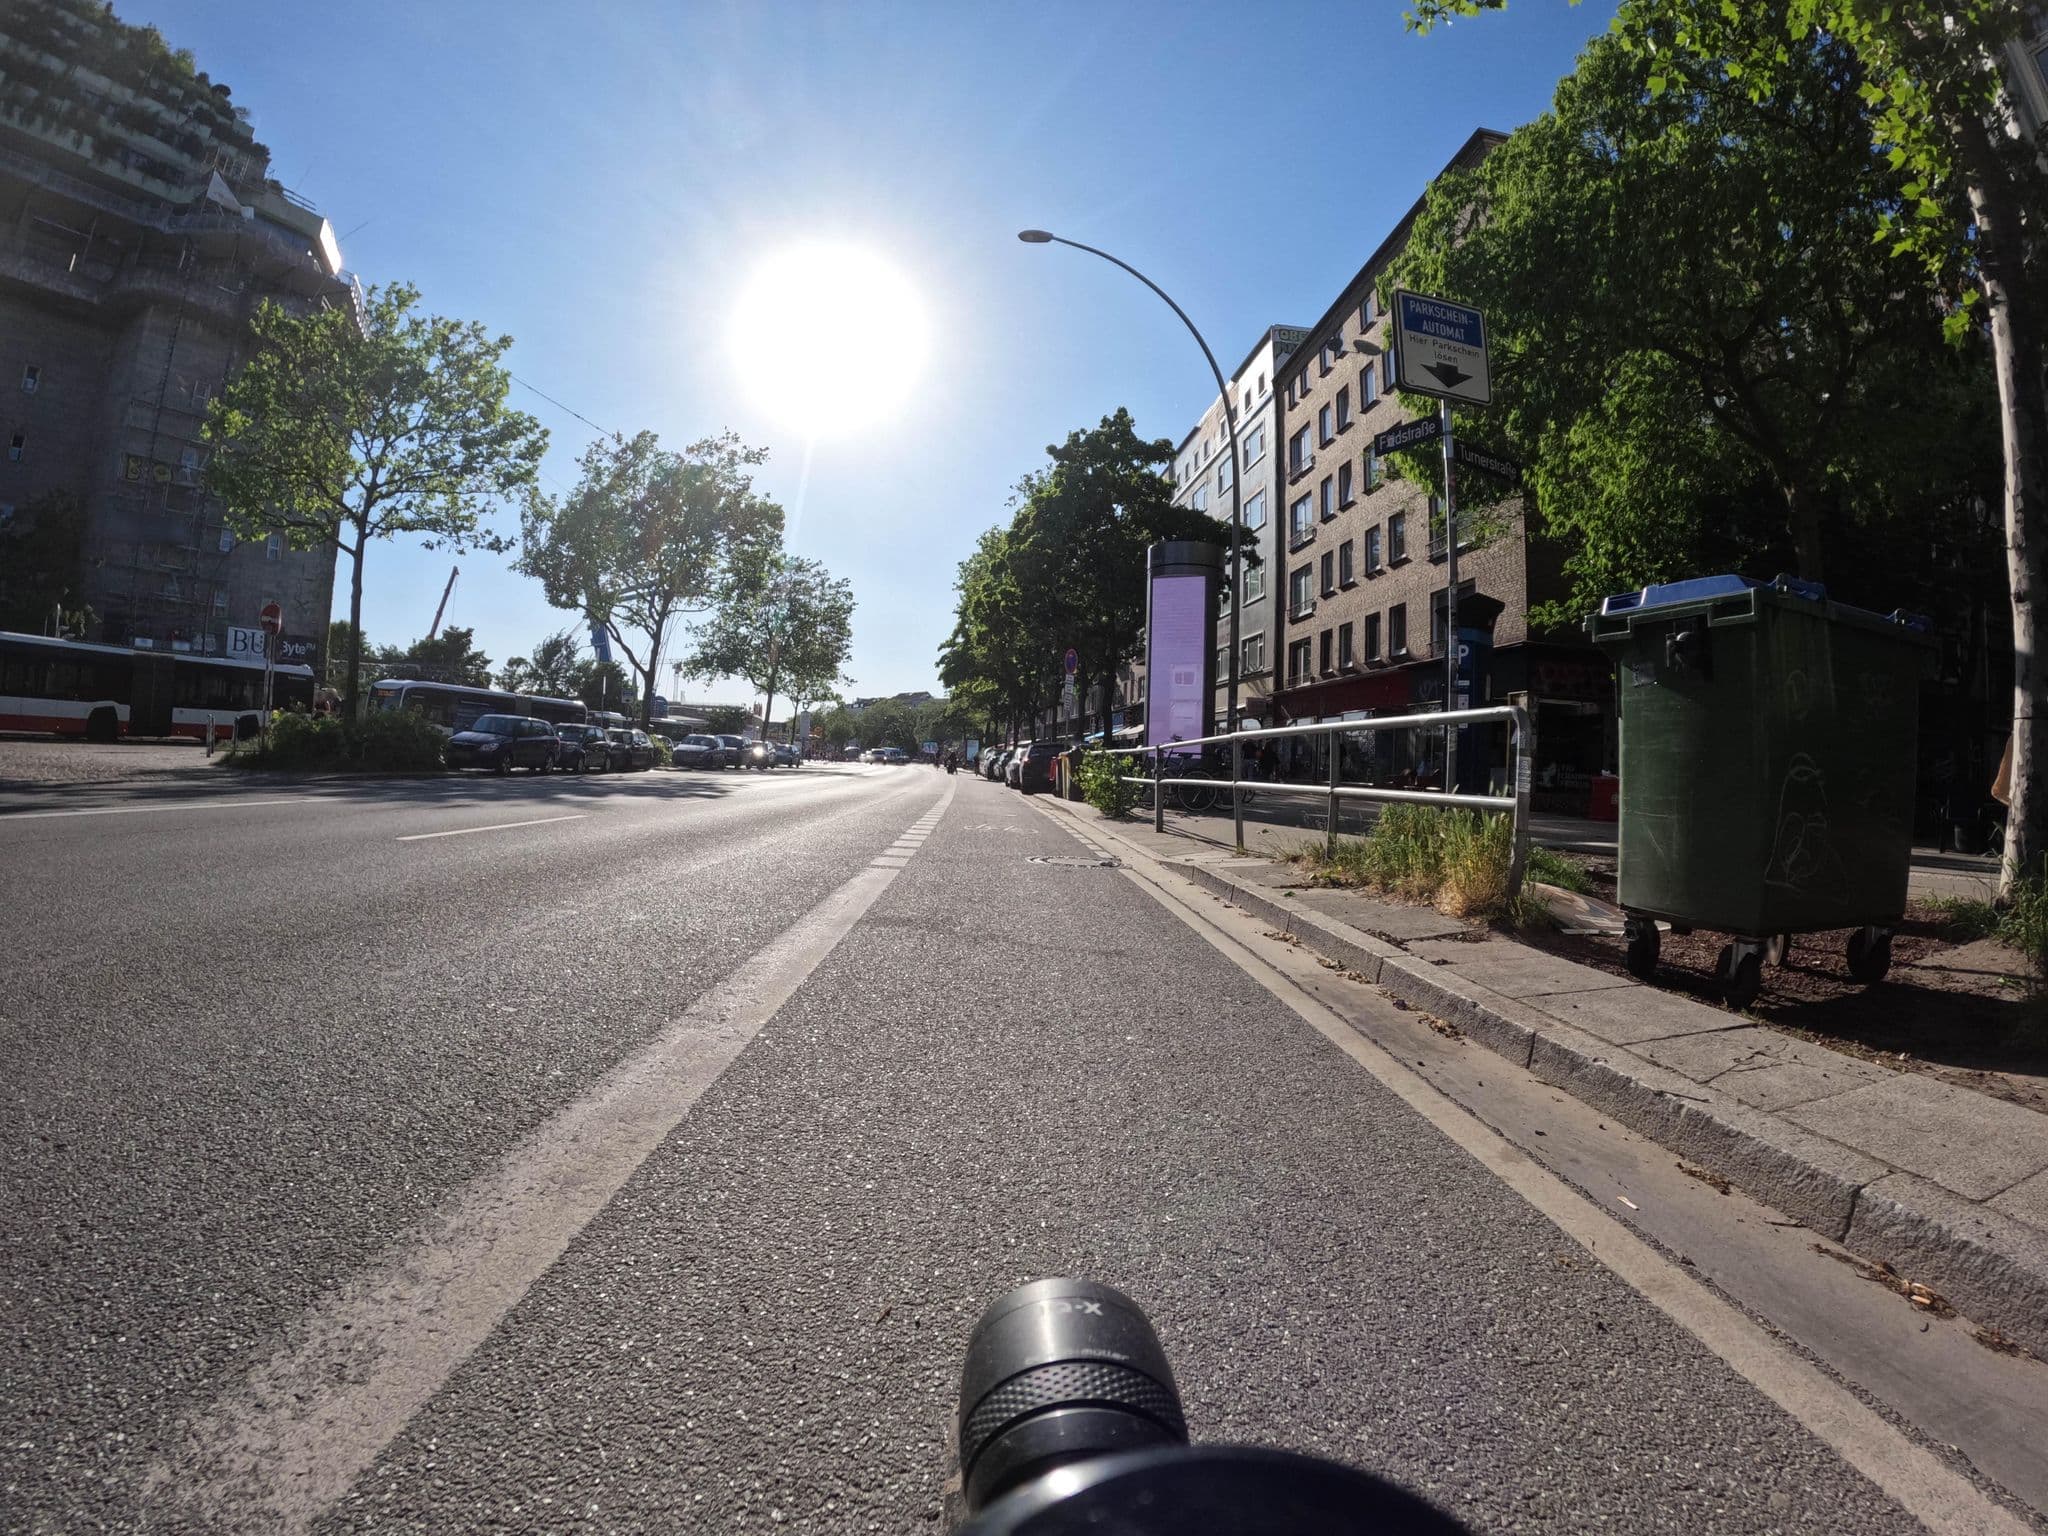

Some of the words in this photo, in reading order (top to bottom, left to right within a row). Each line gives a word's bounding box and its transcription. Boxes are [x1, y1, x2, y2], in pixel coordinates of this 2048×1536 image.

[1410, 300, 1473, 325] PARKSCHEIN-
[1423, 319, 1465, 340] AUTOMAT
[1409, 334, 1428, 345] Hier
[1432, 338, 1480, 359] Parkschein
[1434, 350, 1459, 363] lösen
[1379, 421, 1436, 450] Fdstraße
[1459, 443, 1517, 477] Turnerstraße
